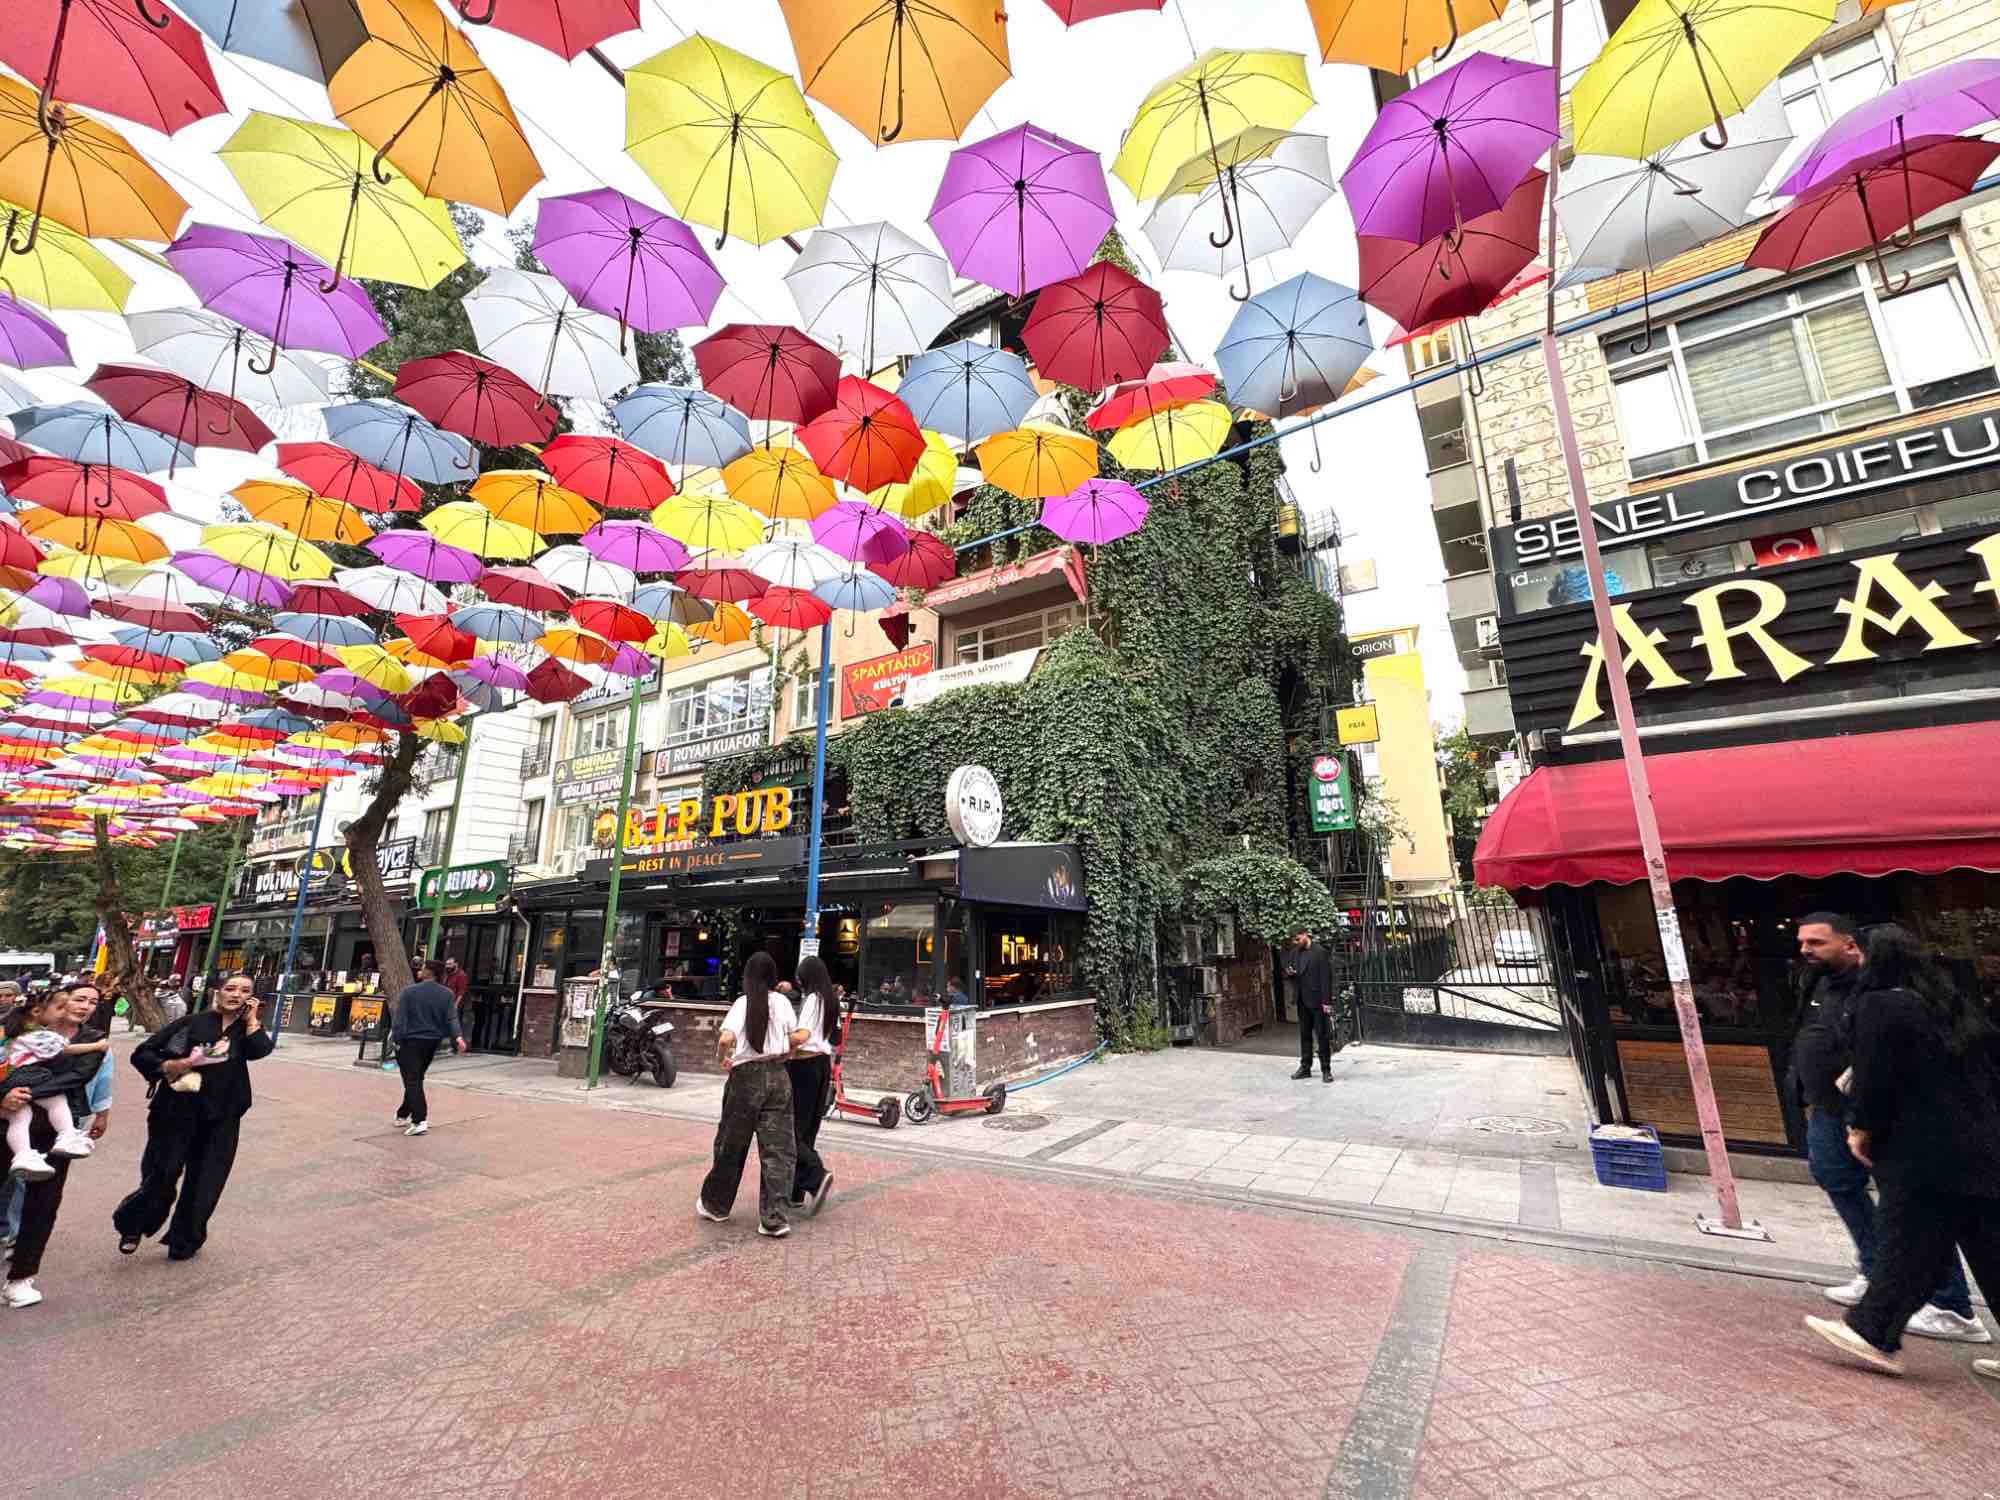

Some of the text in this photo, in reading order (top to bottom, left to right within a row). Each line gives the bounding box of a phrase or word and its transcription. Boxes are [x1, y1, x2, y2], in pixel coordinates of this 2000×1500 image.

[1352, 639, 1393, 656] ORION
[709, 786, 792, 838] PUB
[638, 857, 664, 872] REST
[669, 856, 681, 869] IN
